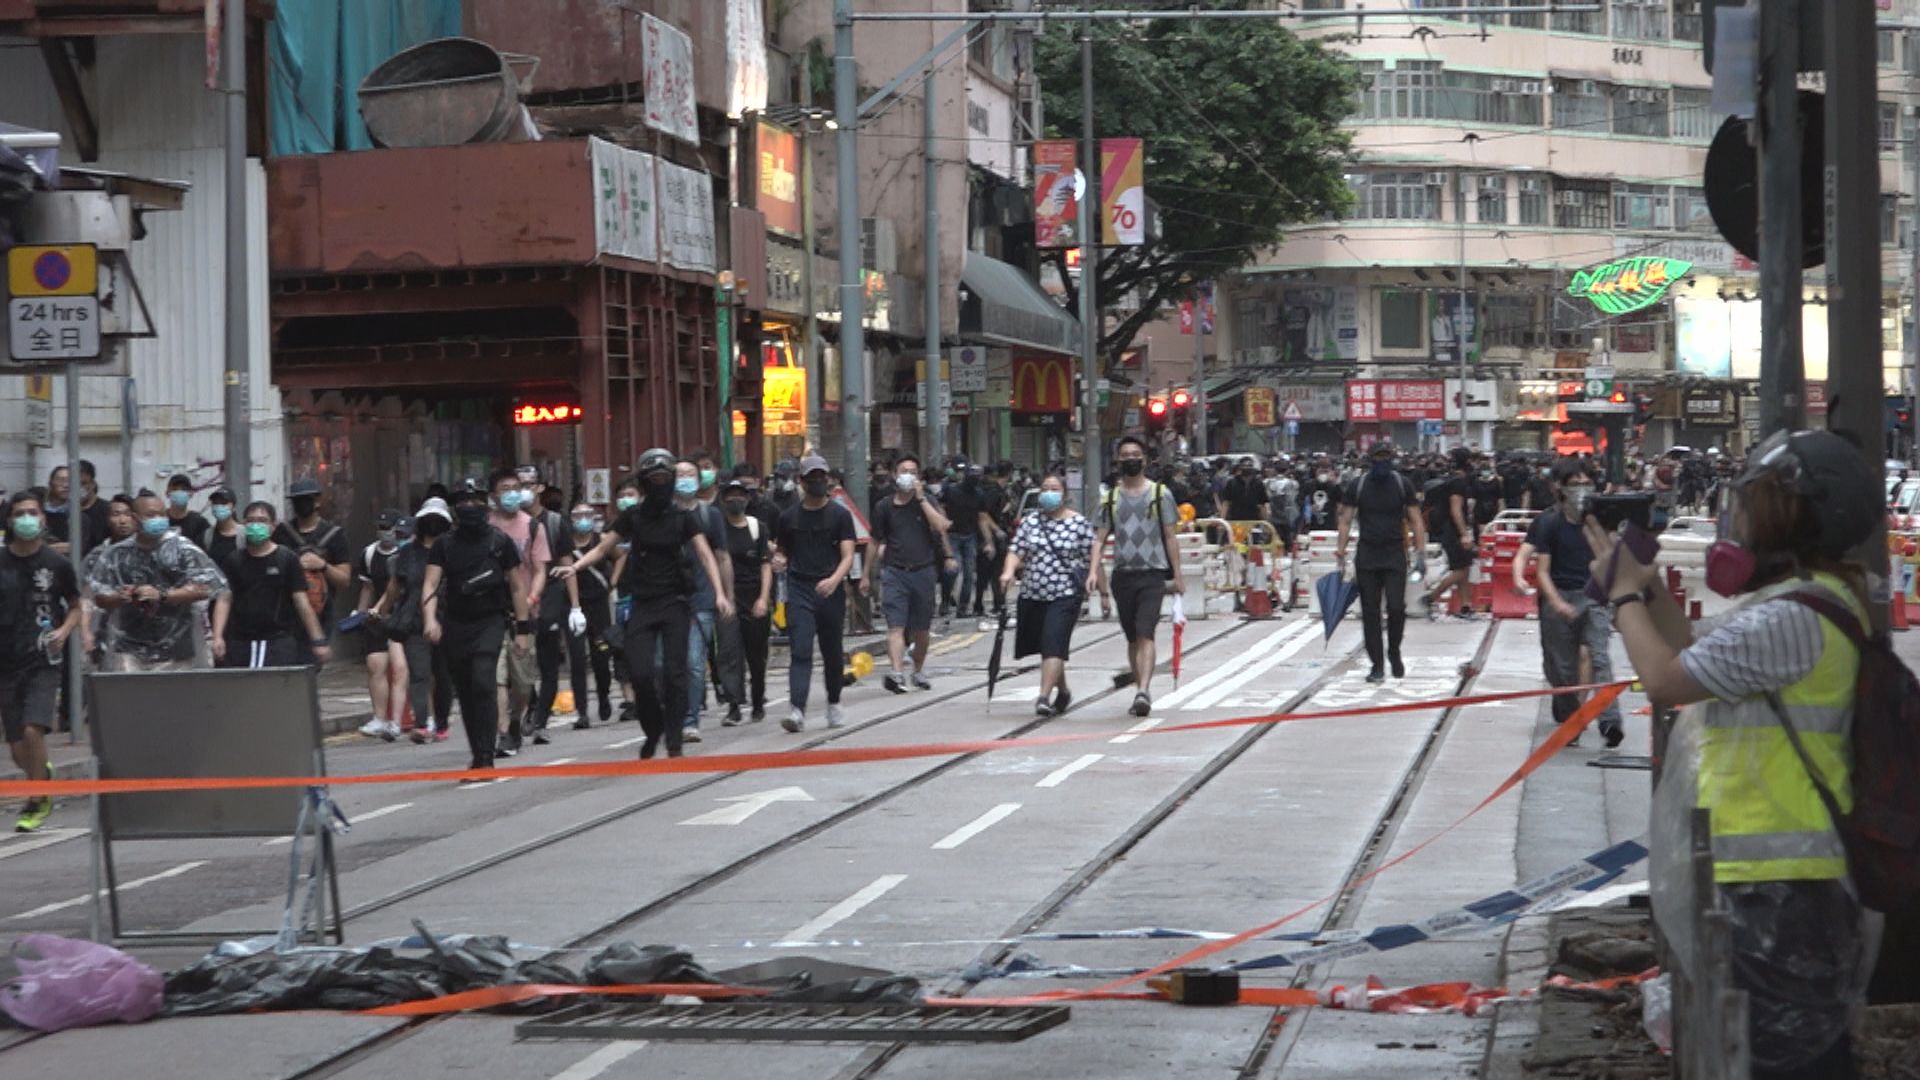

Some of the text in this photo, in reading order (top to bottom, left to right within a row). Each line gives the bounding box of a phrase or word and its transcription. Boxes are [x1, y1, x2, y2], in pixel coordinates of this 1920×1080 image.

[1111, 204, 1136, 230] 70
[19, 303, 89, 321] 24 hrs
[30, 327, 81, 351] 全日
